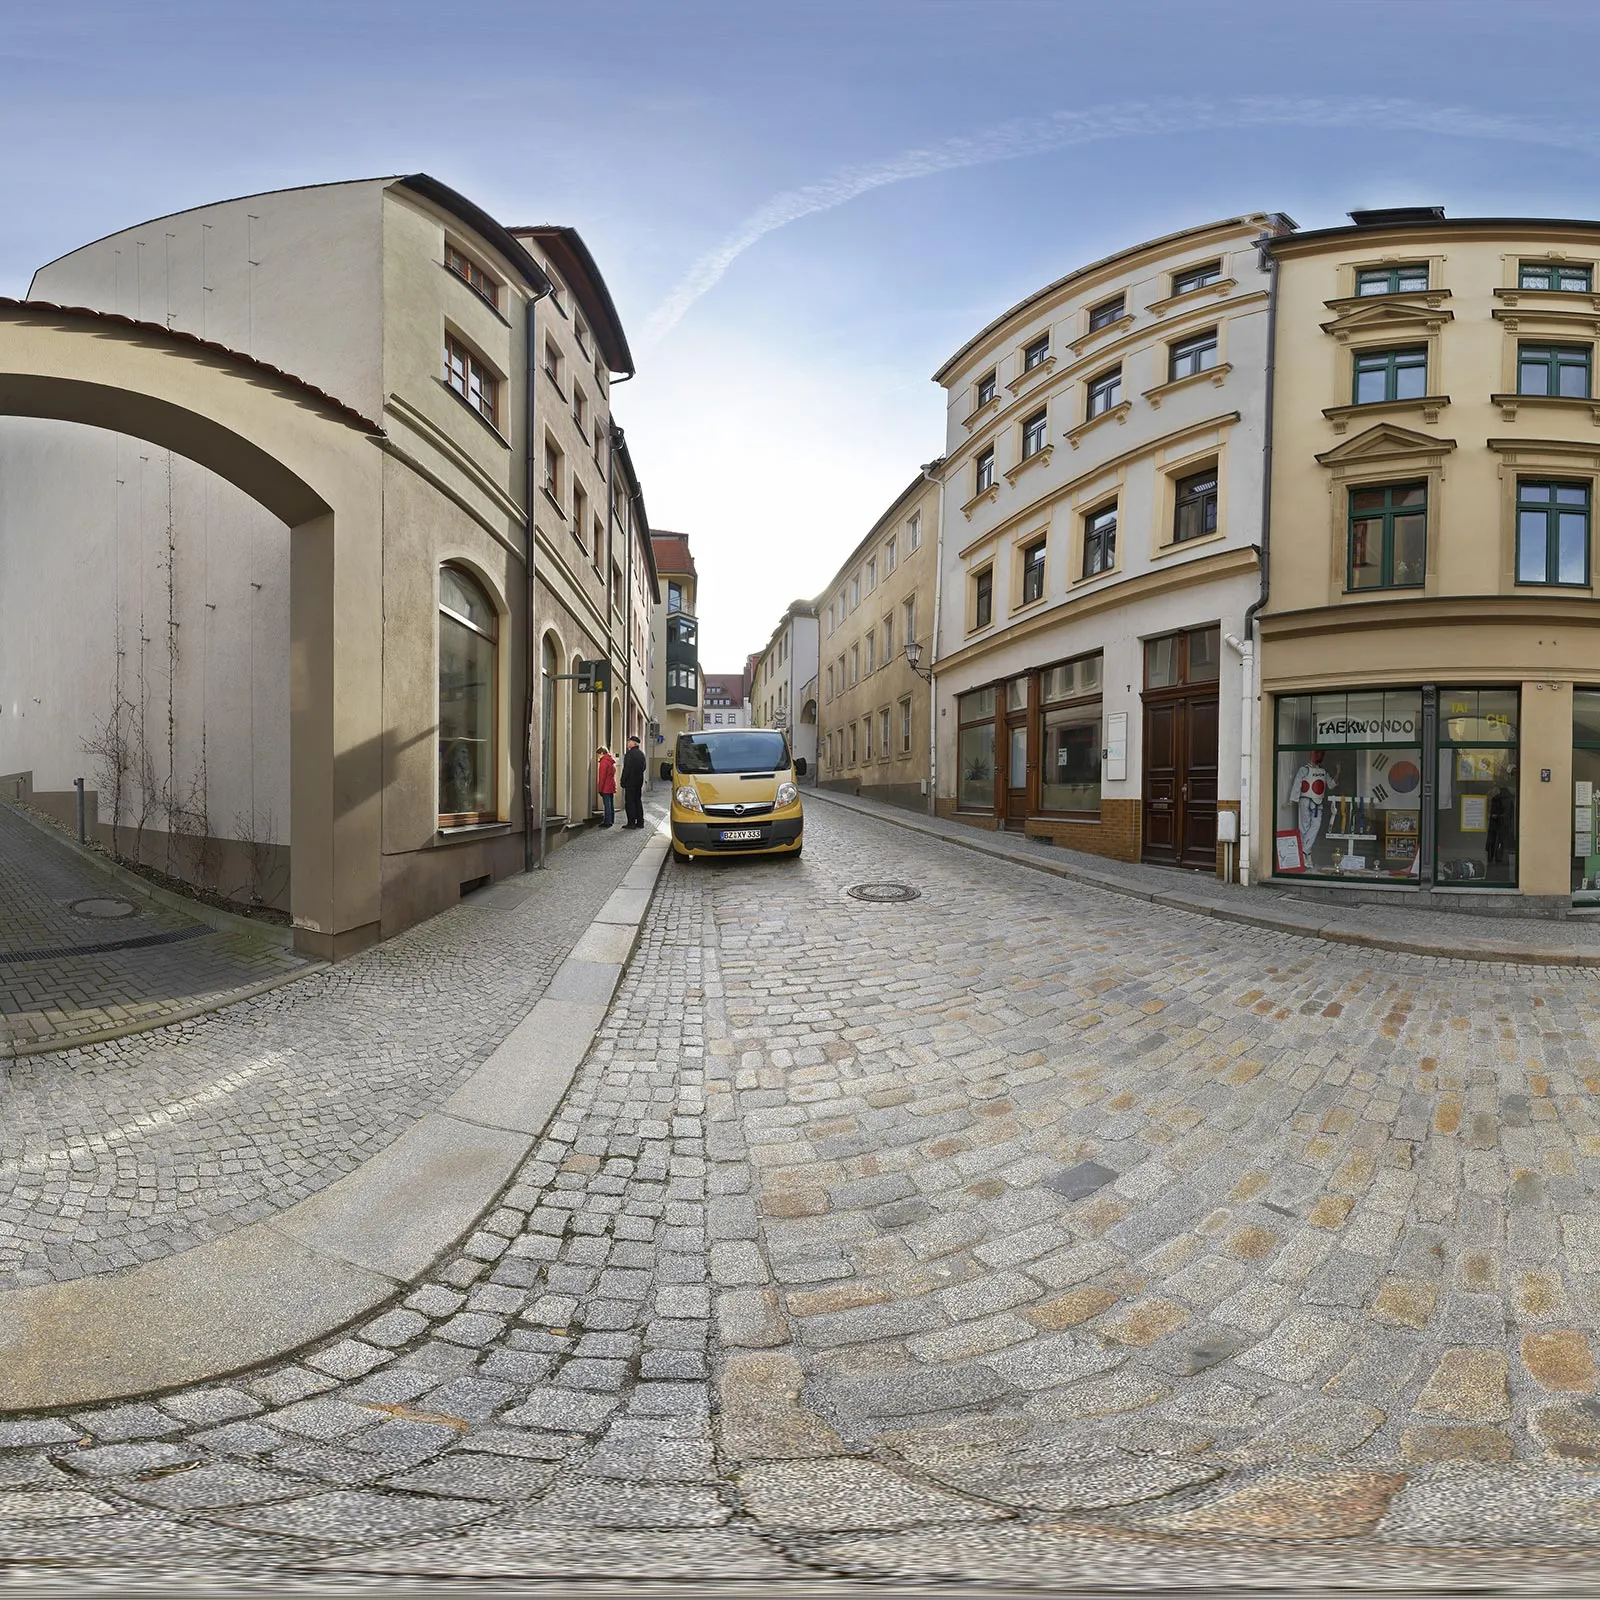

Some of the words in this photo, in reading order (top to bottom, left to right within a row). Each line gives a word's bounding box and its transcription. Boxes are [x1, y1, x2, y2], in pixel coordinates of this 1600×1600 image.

[1450, 702, 1468, 713] TAI
[1486, 713, 1508, 727] CHI
[1318, 719, 1414, 735] TAEKWONDO
